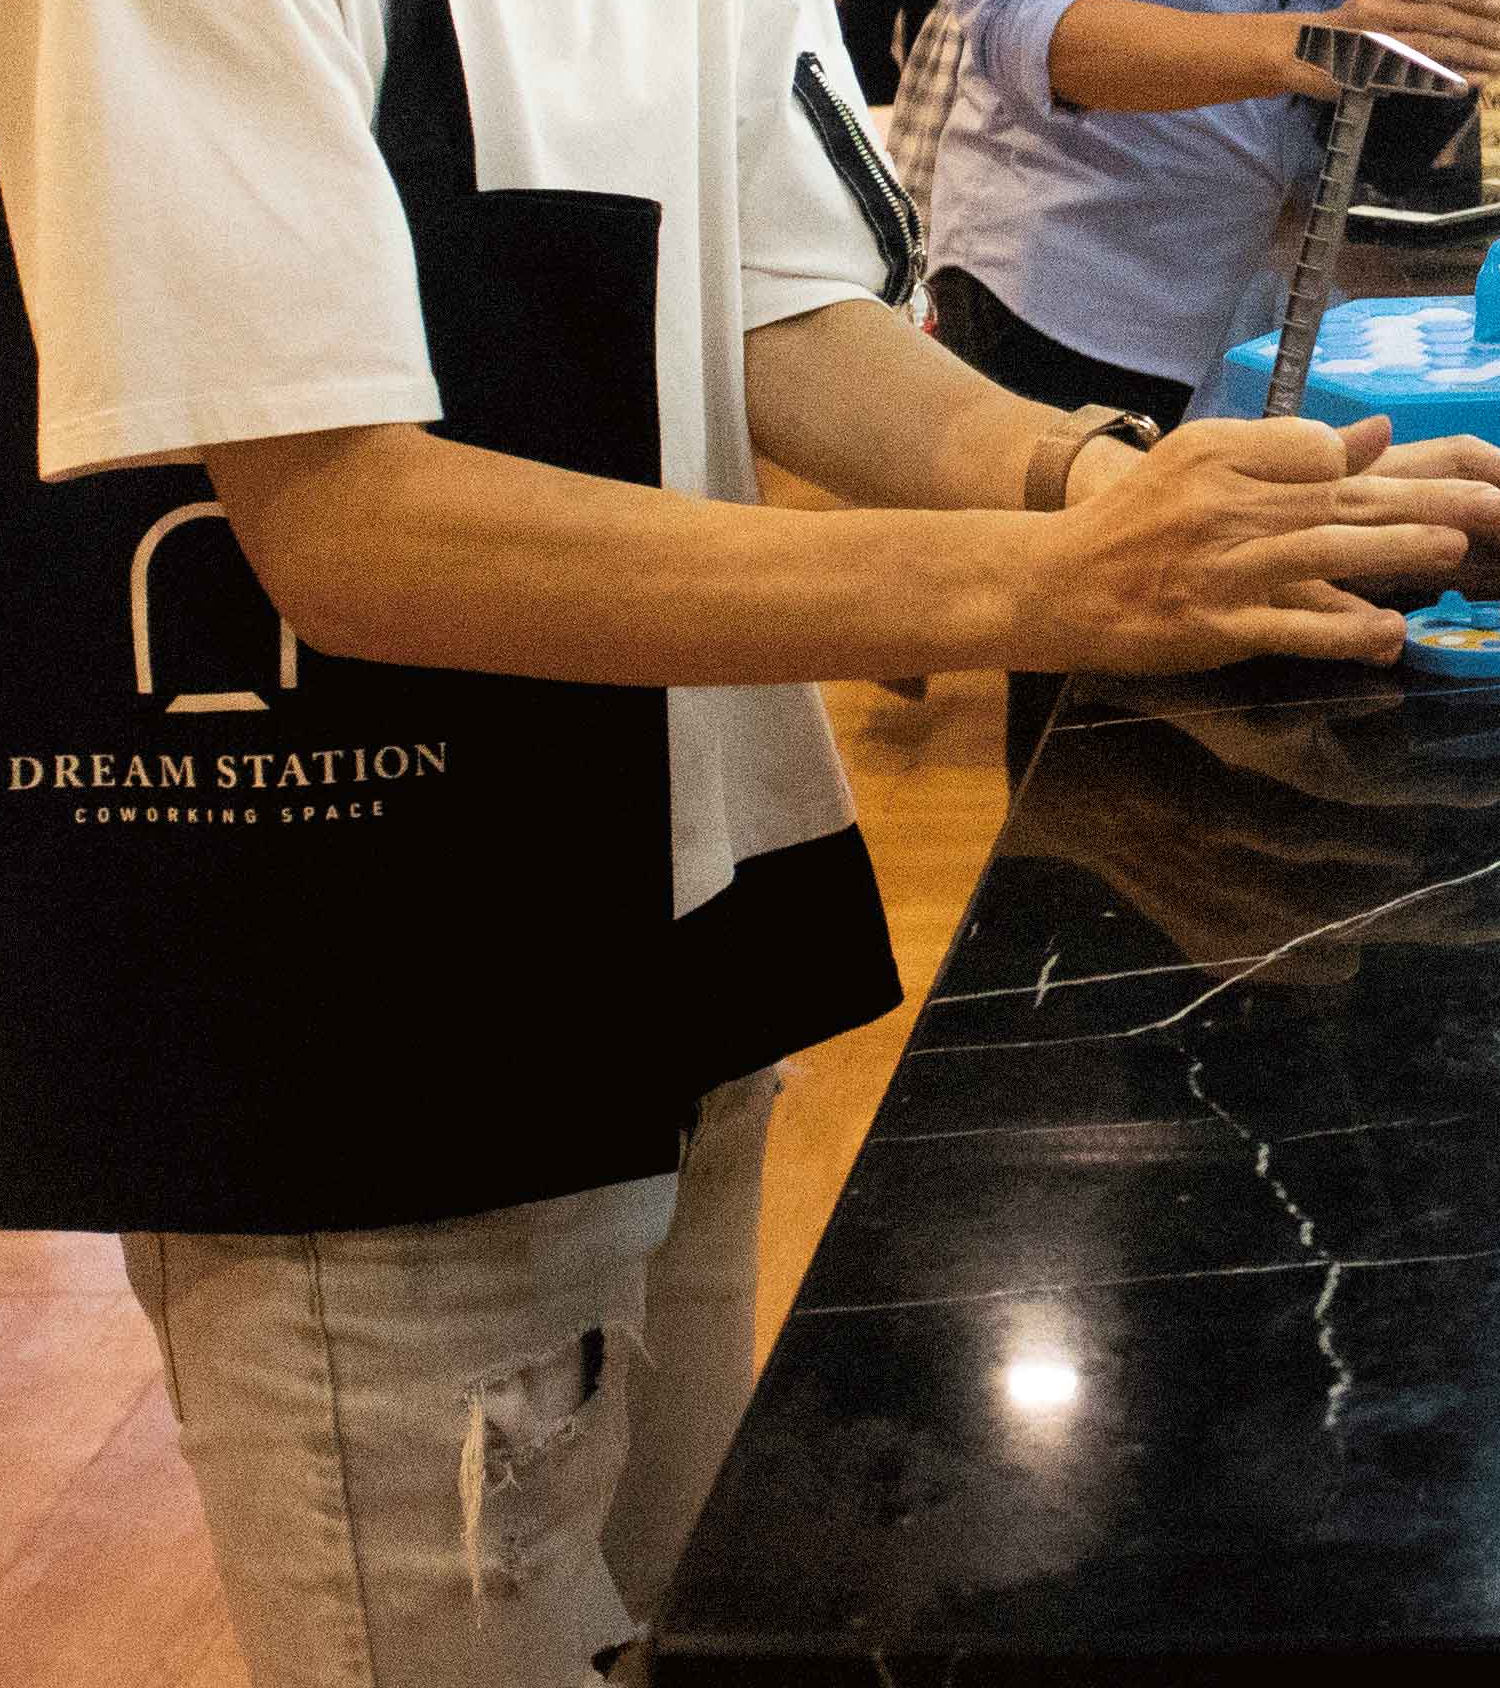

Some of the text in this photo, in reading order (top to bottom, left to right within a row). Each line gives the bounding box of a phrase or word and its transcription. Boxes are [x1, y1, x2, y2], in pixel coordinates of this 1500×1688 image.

[7, 741, 448, 791] DREAM STATION
[74, 800, 385, 825] COWORKING SPACE
